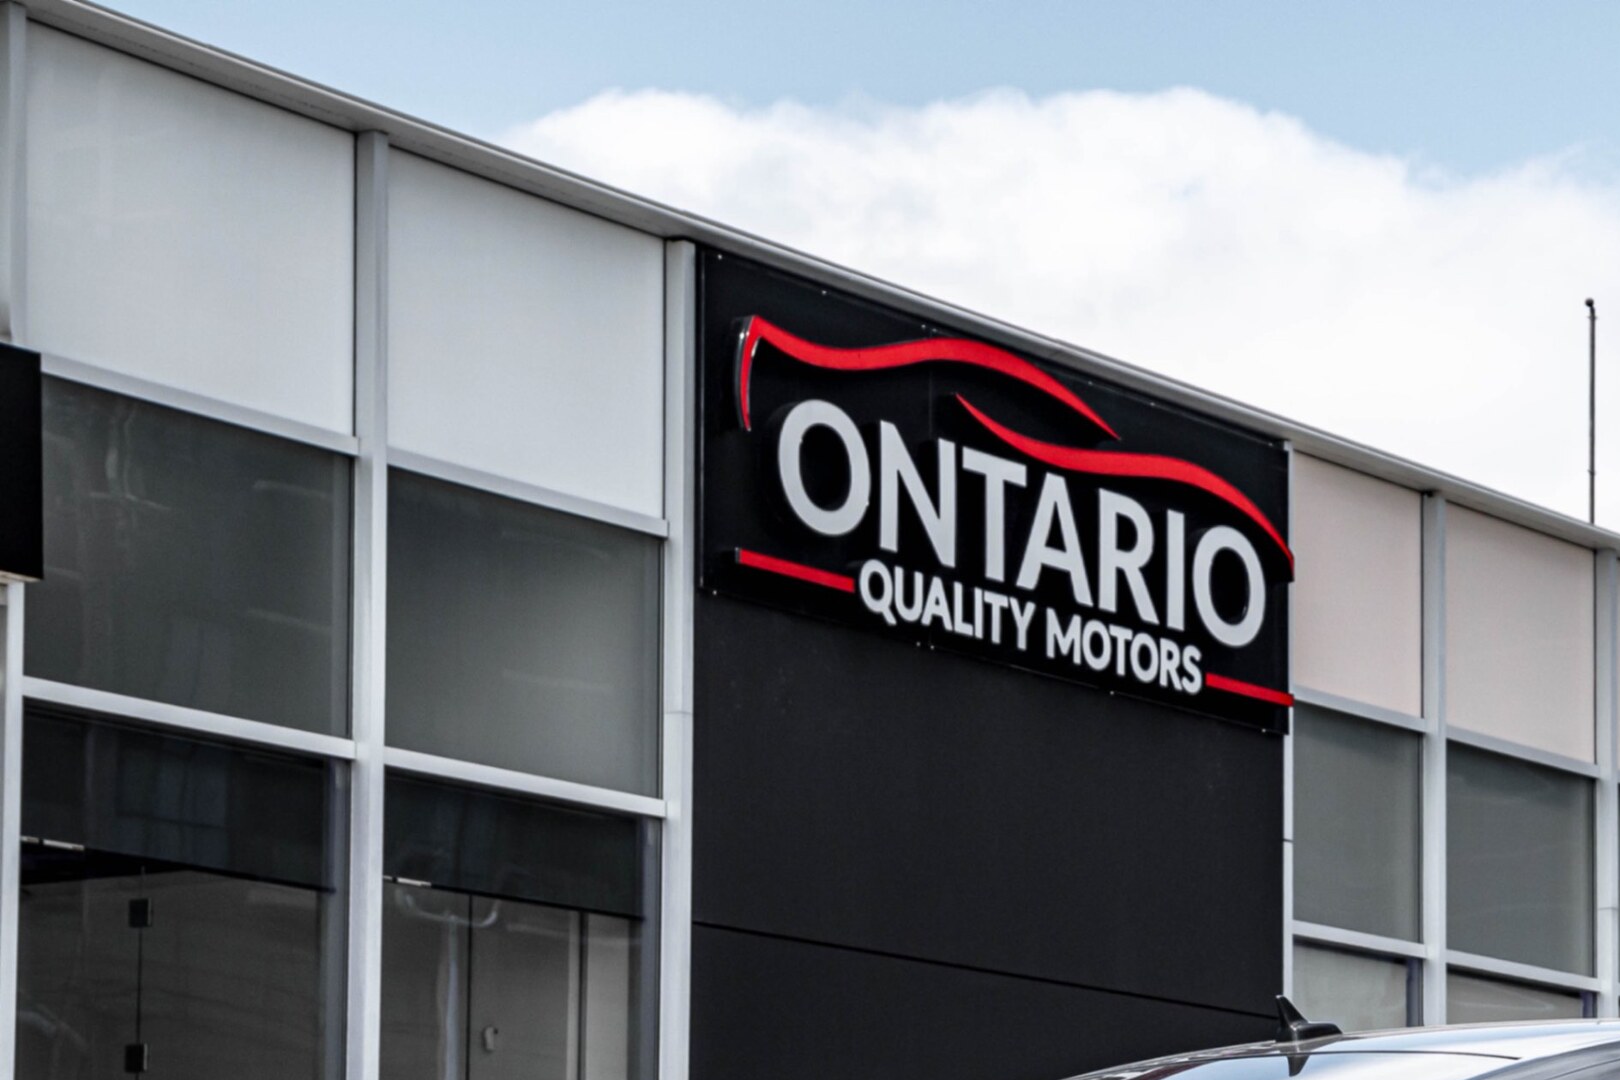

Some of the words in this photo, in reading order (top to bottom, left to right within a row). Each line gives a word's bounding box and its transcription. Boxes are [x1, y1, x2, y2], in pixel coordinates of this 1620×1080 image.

[778, 399, 1266, 647] ONTARIO
[859, 558, 1036, 651] QUALITY
[1045, 607, 1203, 695] MOTORS
